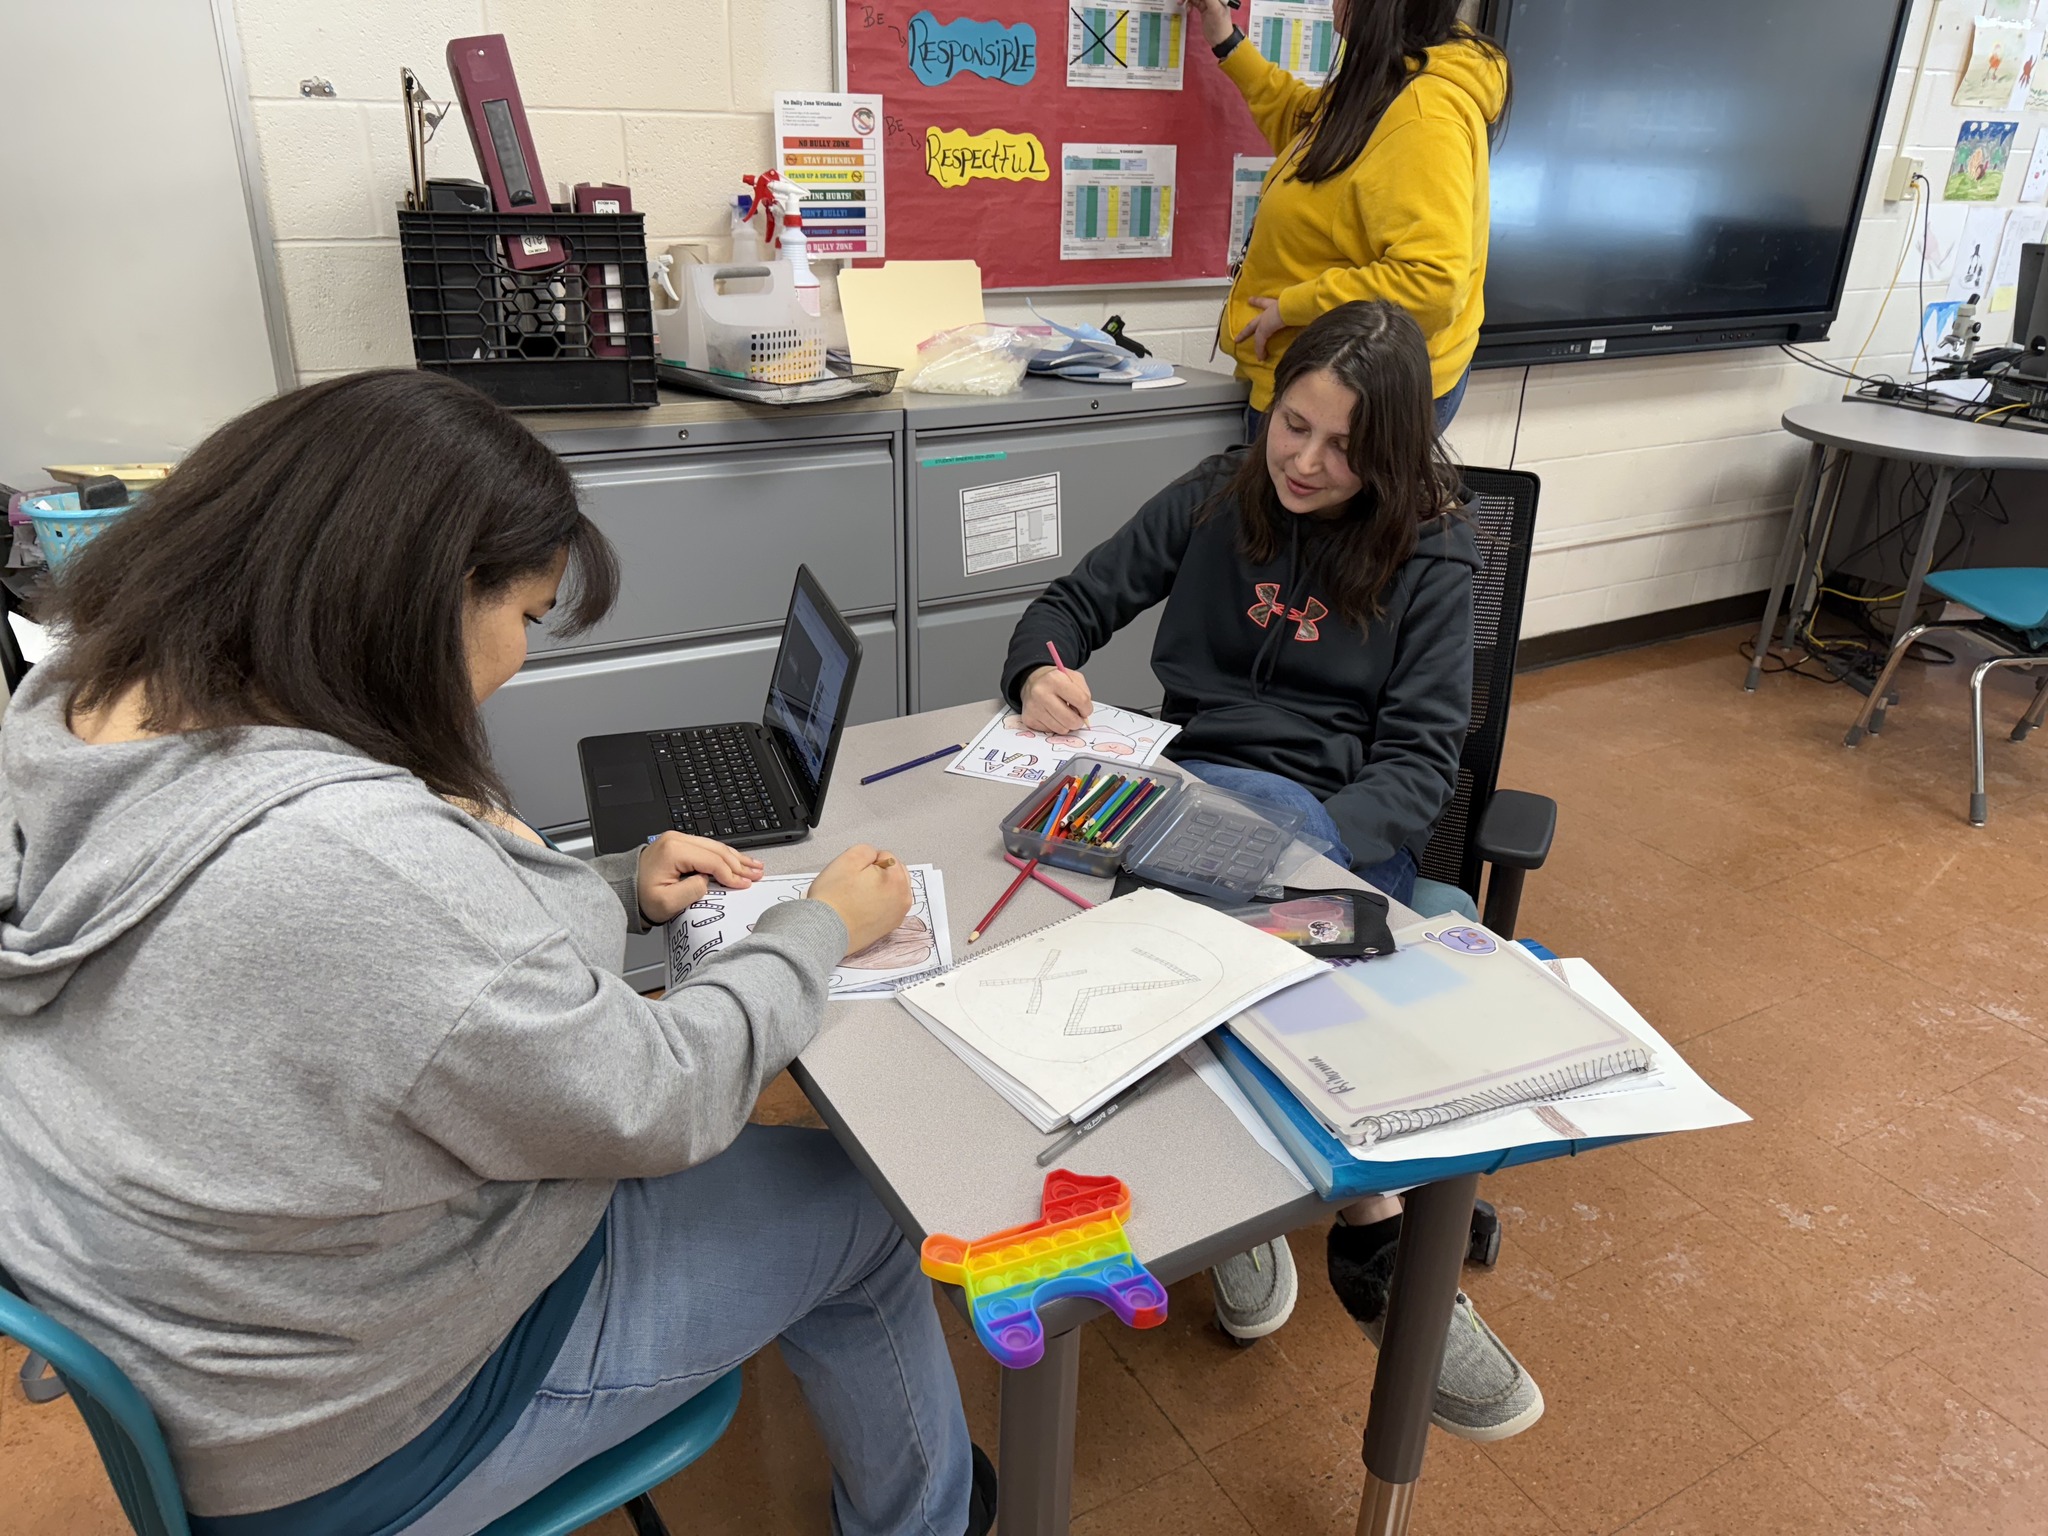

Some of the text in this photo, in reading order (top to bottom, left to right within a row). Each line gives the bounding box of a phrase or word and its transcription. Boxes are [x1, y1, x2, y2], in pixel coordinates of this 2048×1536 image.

[861, 5, 885, 28] BE
[883, 115, 905, 136] BE
[832, 140, 850, 148] ZONE
[803, 156, 821, 164] STAY
[825, 192, 852, 200] HURTS!
[801, 209, 848, 217] DON'T BULLY!
[812, 242, 834, 251] BULLY
[835, 242, 853, 250] ZONE
[1308, 1055, 1356, 1095] Rihanna
